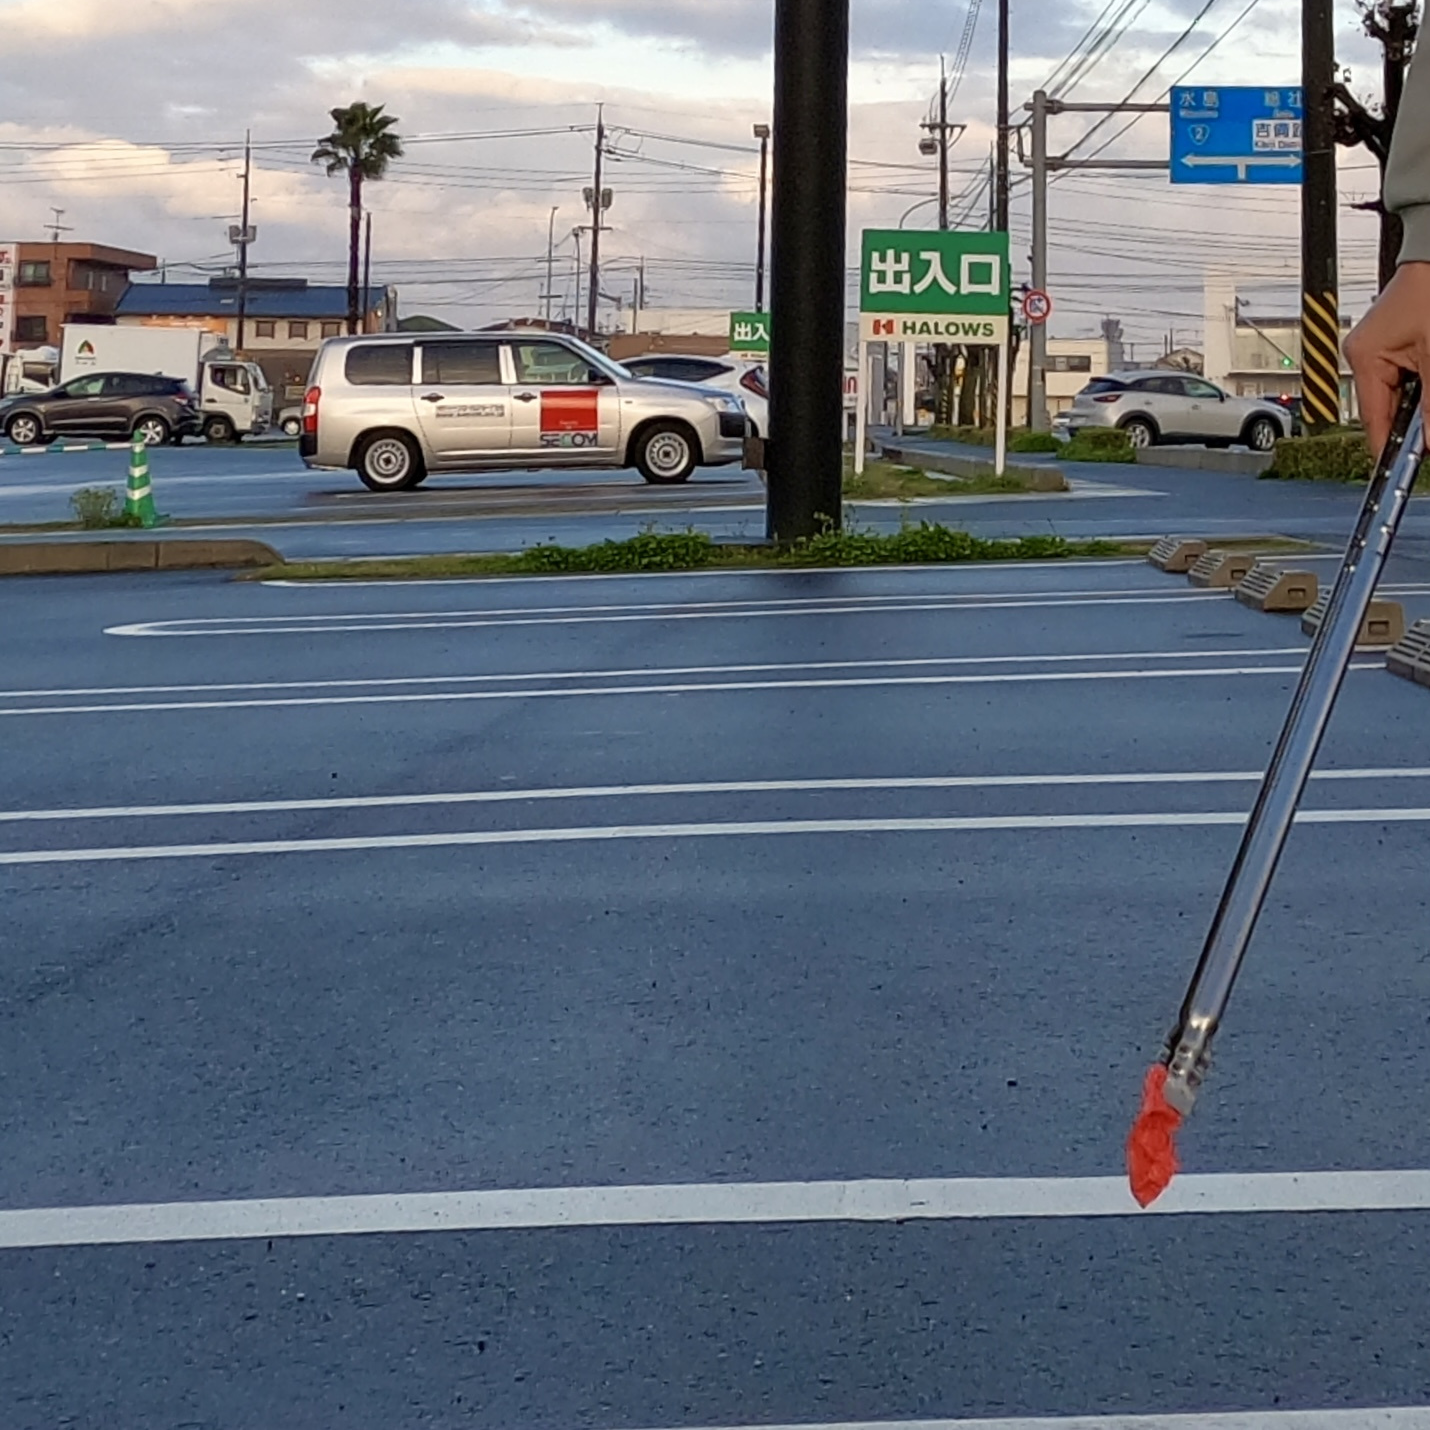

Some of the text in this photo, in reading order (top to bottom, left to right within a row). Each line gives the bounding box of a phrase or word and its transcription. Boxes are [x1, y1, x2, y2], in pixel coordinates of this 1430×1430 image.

[868, 249, 1000, 295] 出入口
[902, 321, 995, 337] HALOWS
[540, 432, 598, 448] SECOM
